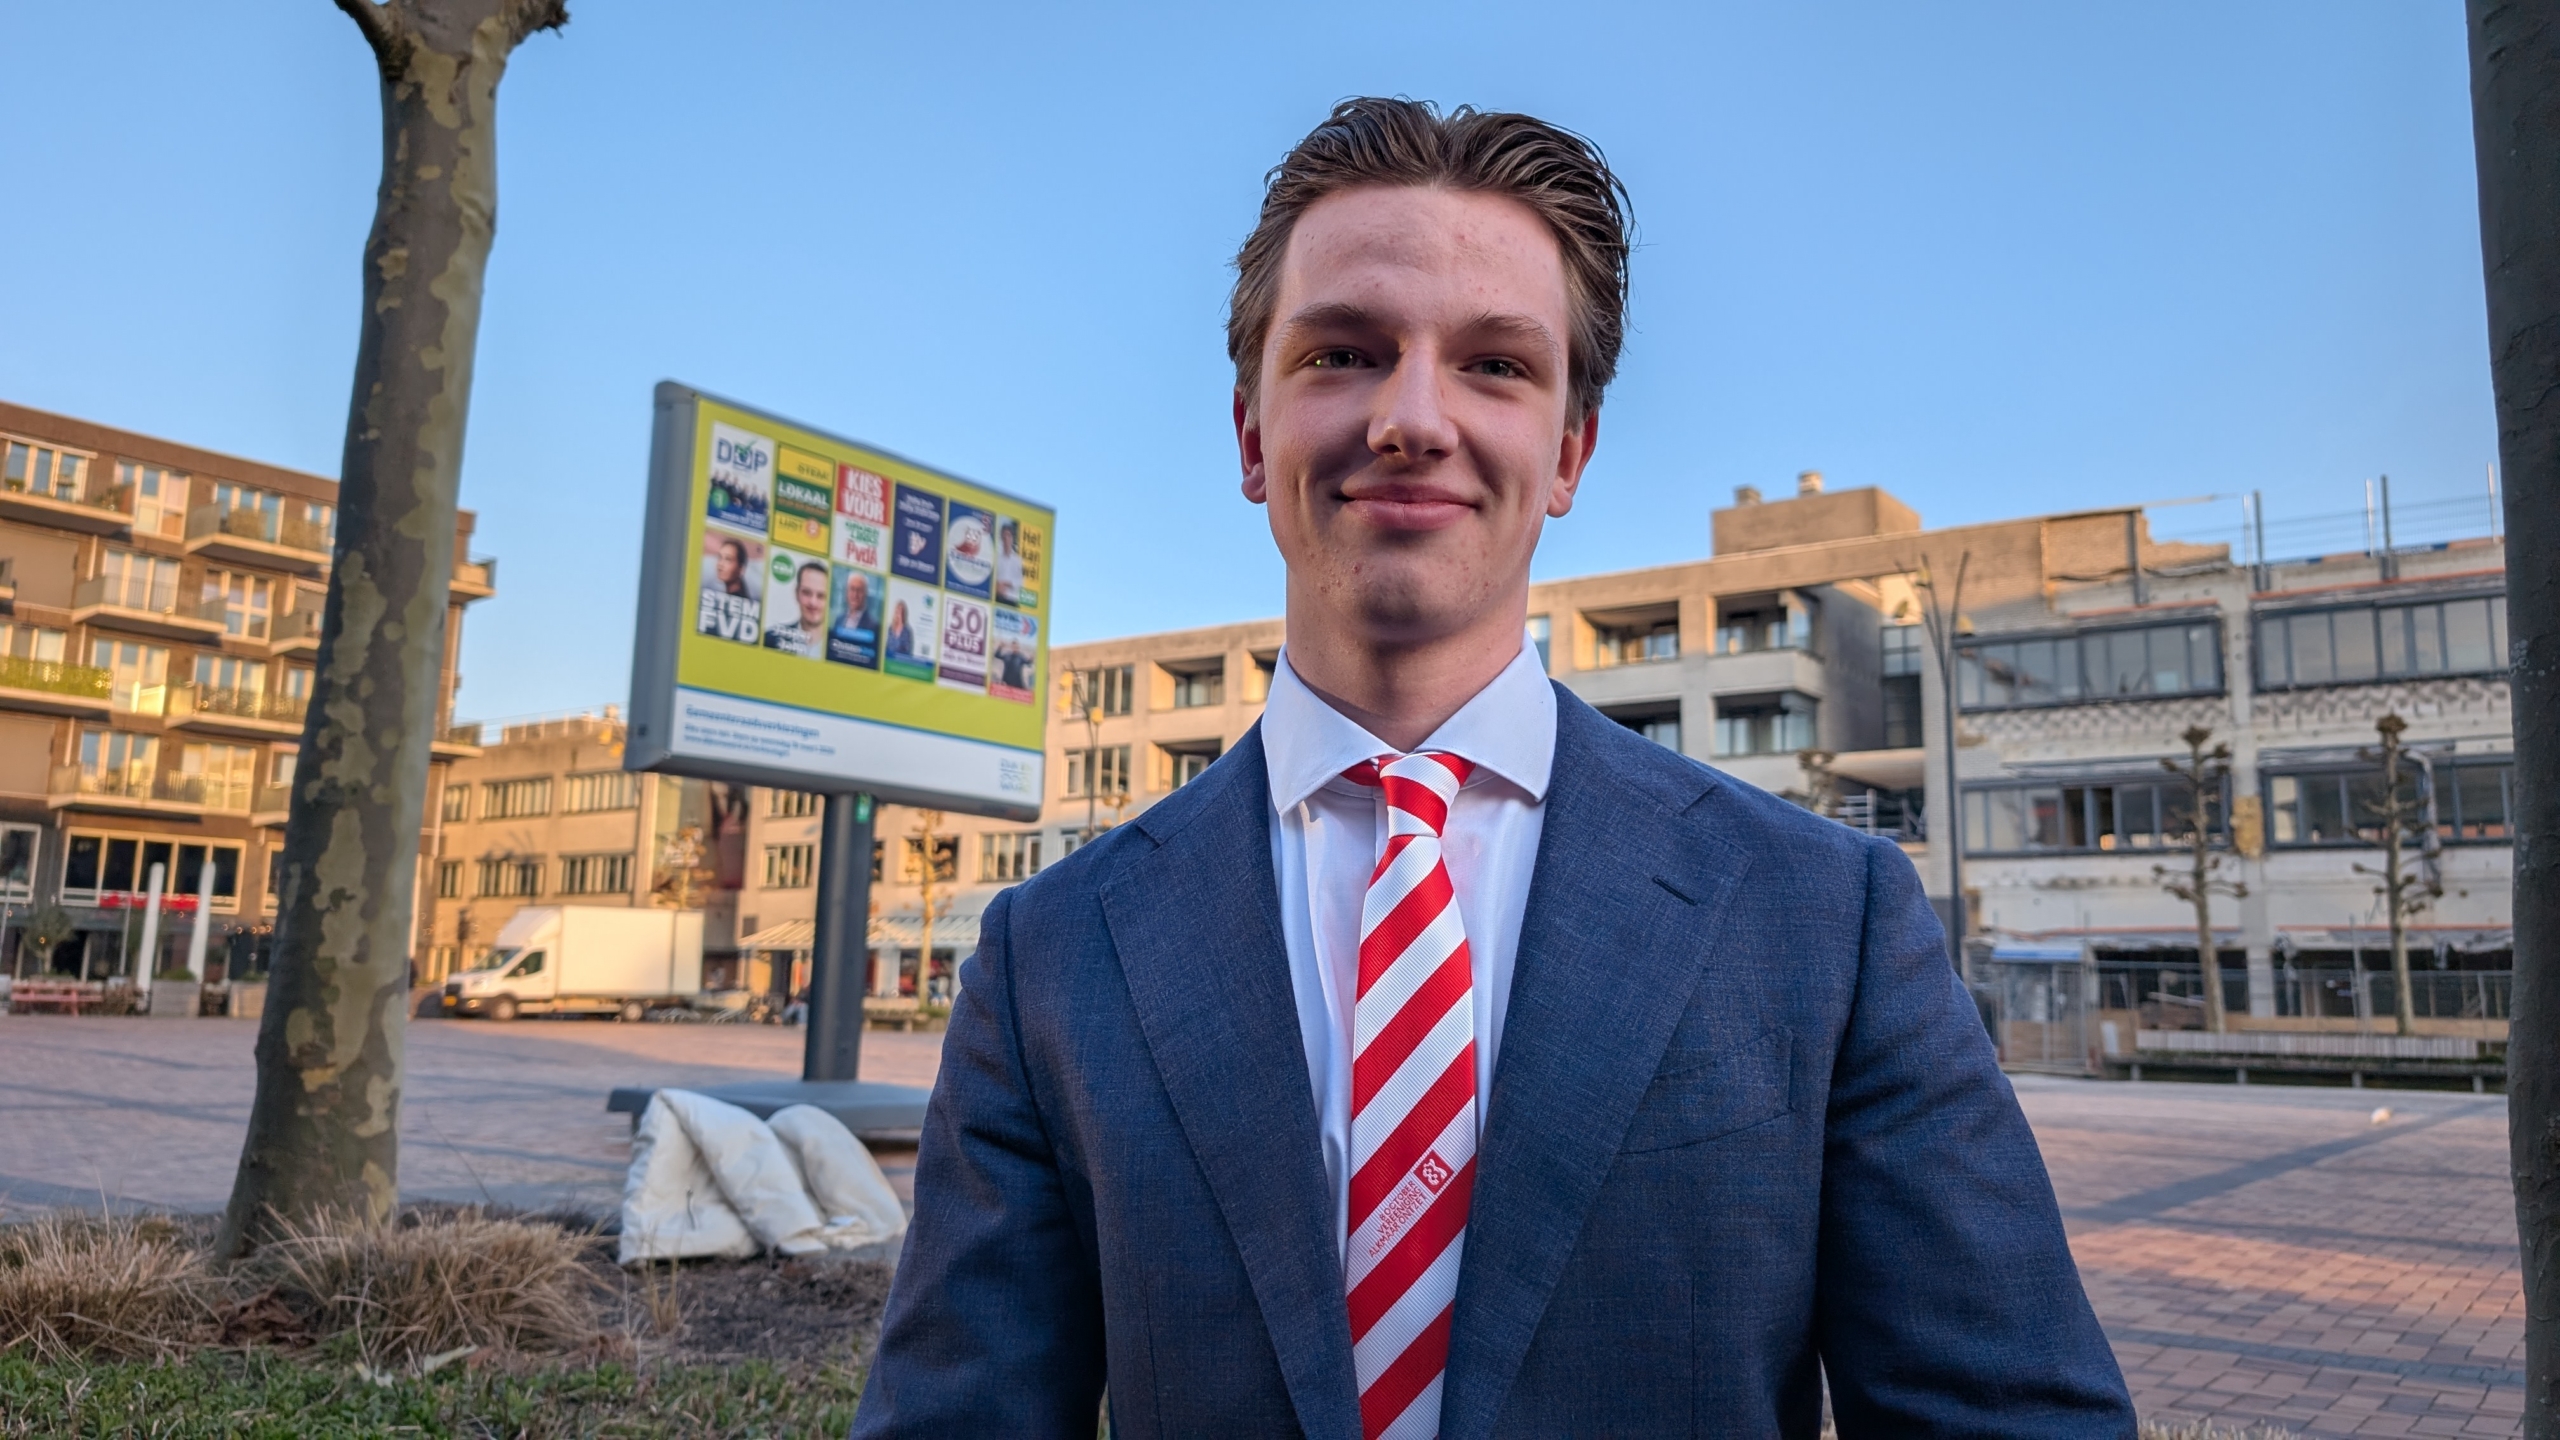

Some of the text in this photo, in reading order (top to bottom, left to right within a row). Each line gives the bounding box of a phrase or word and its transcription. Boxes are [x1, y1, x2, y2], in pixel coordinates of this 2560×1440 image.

[778, 481, 829, 511] LOKAAL
[846, 468, 883, 498] KIES
[843, 487, 884, 523] VOOR
[1022, 525, 1041, 547] Het
[846, 539, 878, 567] PvdA
[701, 588, 760, 619] STEM
[698, 611, 760, 644] FVD
[950, 604, 982, 634] 50
[948, 633, 980, 653] PLUS
[1376, 1186, 1422, 1234] VEREENIGING
[1384, 1180, 1416, 1215] OCTOBER
[1368, 1193, 1427, 1258] ALKMAAR ONTZET
